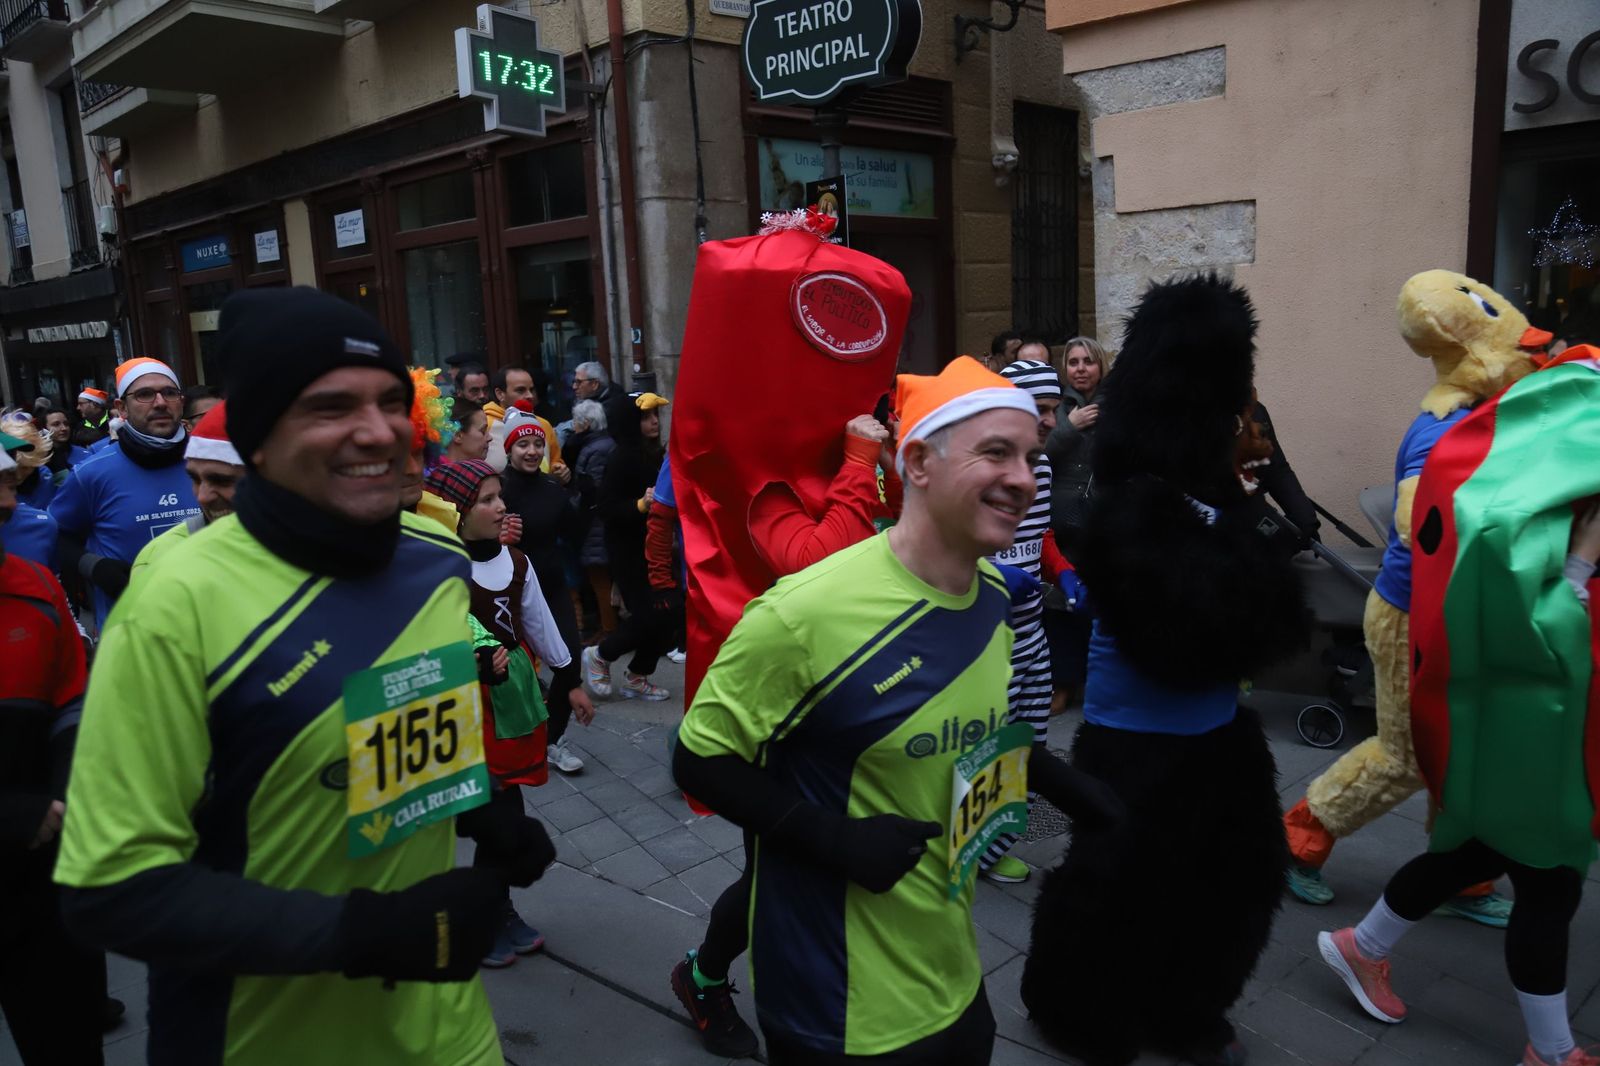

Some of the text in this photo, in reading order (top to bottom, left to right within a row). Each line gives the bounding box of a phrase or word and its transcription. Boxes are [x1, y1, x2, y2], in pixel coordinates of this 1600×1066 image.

[774, 0, 853, 39] TEATRO
[479, 50, 554, 94] 17:32
[765, 33, 870, 79] PRINCIPAL
[795, 153, 809, 166] Un
[857, 155, 866, 171] la
[869, 158, 897, 173] salud
[196, 245, 219, 259] NUXE
[518, 427, 533, 437] HO
[135, 514, 150, 522] SAN
[151, 509, 185, 520] SILVESTRE
[158, 493, 179, 507] 46
[873, 662, 912, 695] luanvi
[366, 698, 458, 792] 1155
[427, 779, 483, 811] RURAL
